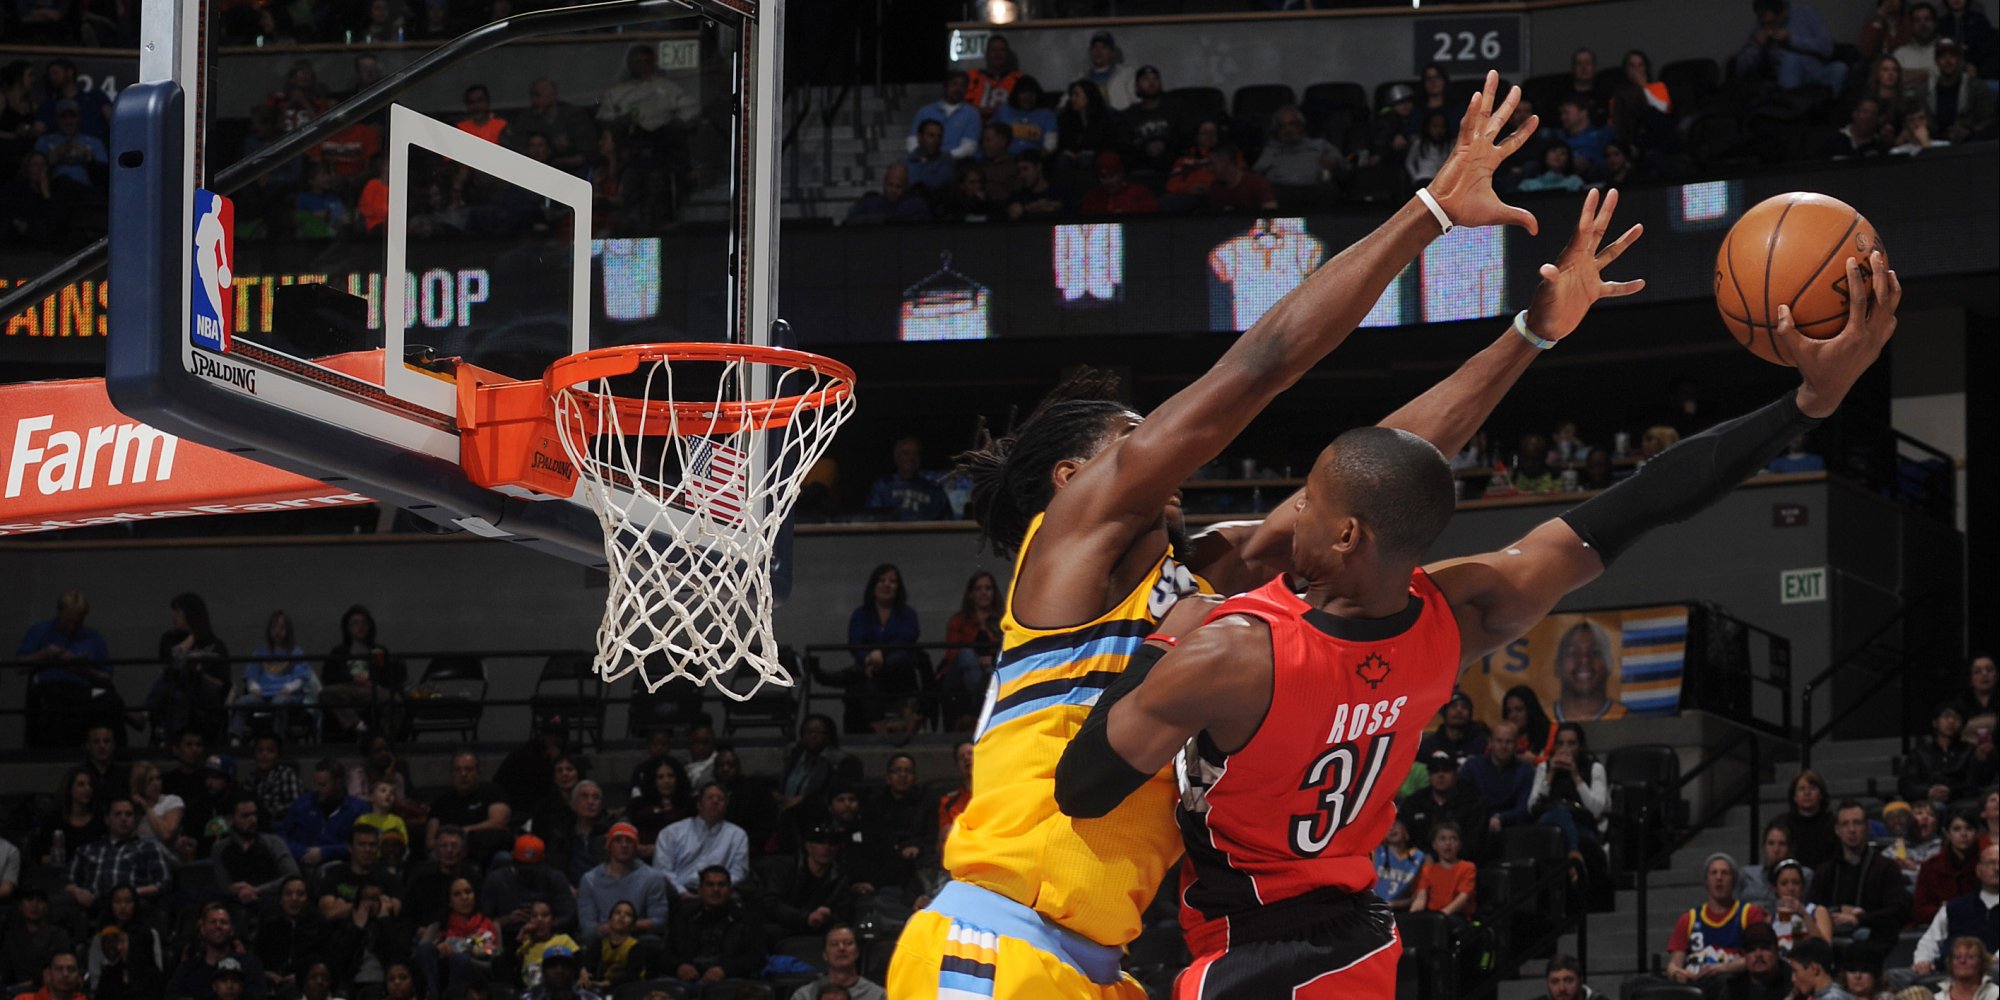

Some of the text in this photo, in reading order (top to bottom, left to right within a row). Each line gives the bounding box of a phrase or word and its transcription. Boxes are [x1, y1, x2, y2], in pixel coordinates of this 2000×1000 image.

[661, 43, 696, 66] EXIT
[1432, 30, 1502, 61] 226
[196, 313, 220, 342] NBA
[191, 350, 258, 395] SPALDING
[5, 414, 180, 499] Farm
[531, 451, 574, 481] SPALDING
[1785, 572, 1822, 598] EXIT
[1326, 695, 1408, 744] ROSS
[1288, 731, 1397, 858] 31
